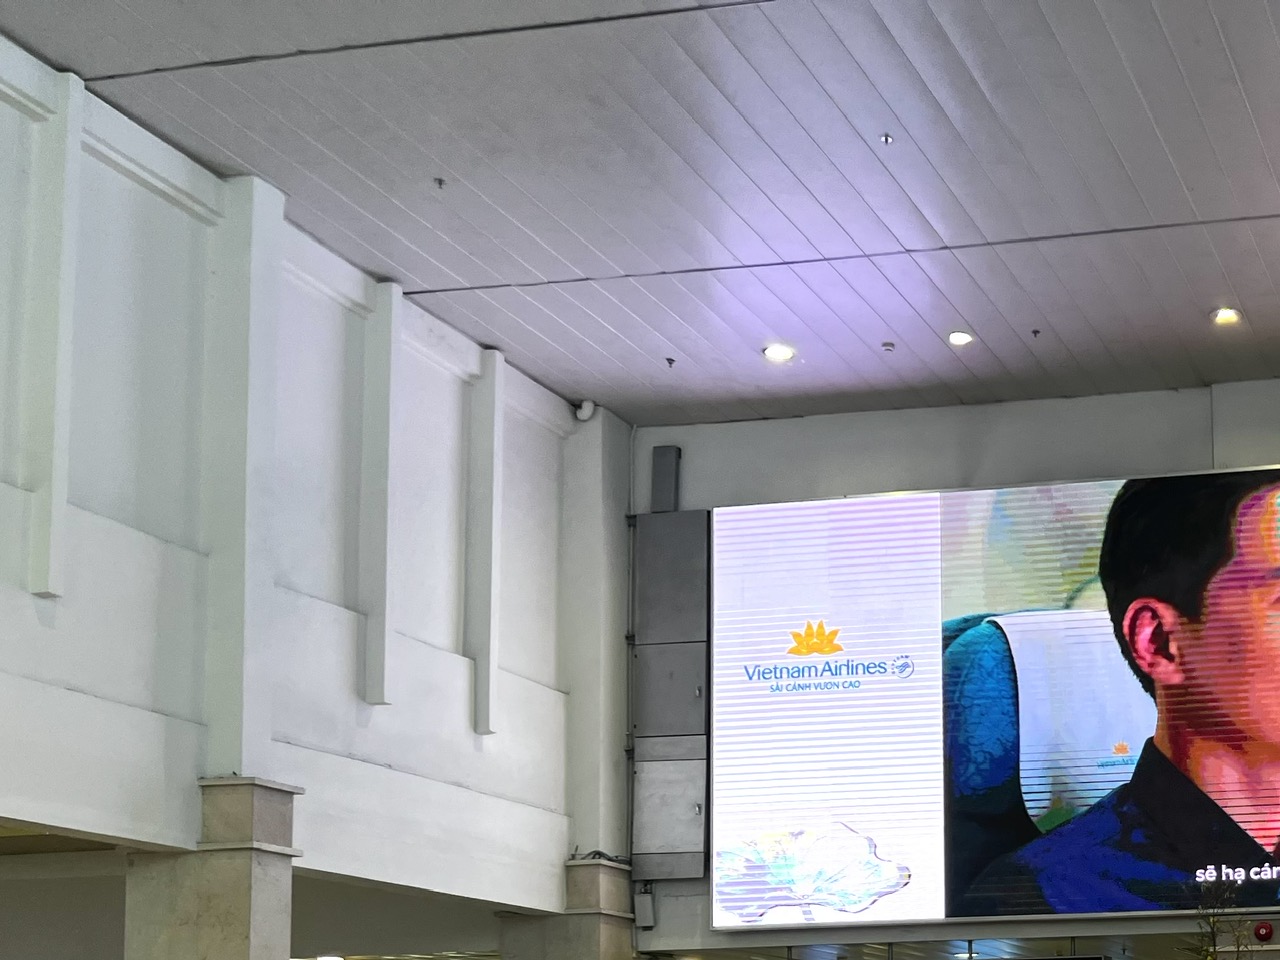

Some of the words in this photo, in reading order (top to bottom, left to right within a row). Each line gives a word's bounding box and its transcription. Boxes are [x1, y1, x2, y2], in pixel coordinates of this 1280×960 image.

[744, 664, 818, 681] Vietnam
[820, 660, 887, 677] Airlines
[842, 680, 861, 689] CAO
[1195, 864, 1217, 882] sẽ
[1222, 864, 1245, 884] hạ
